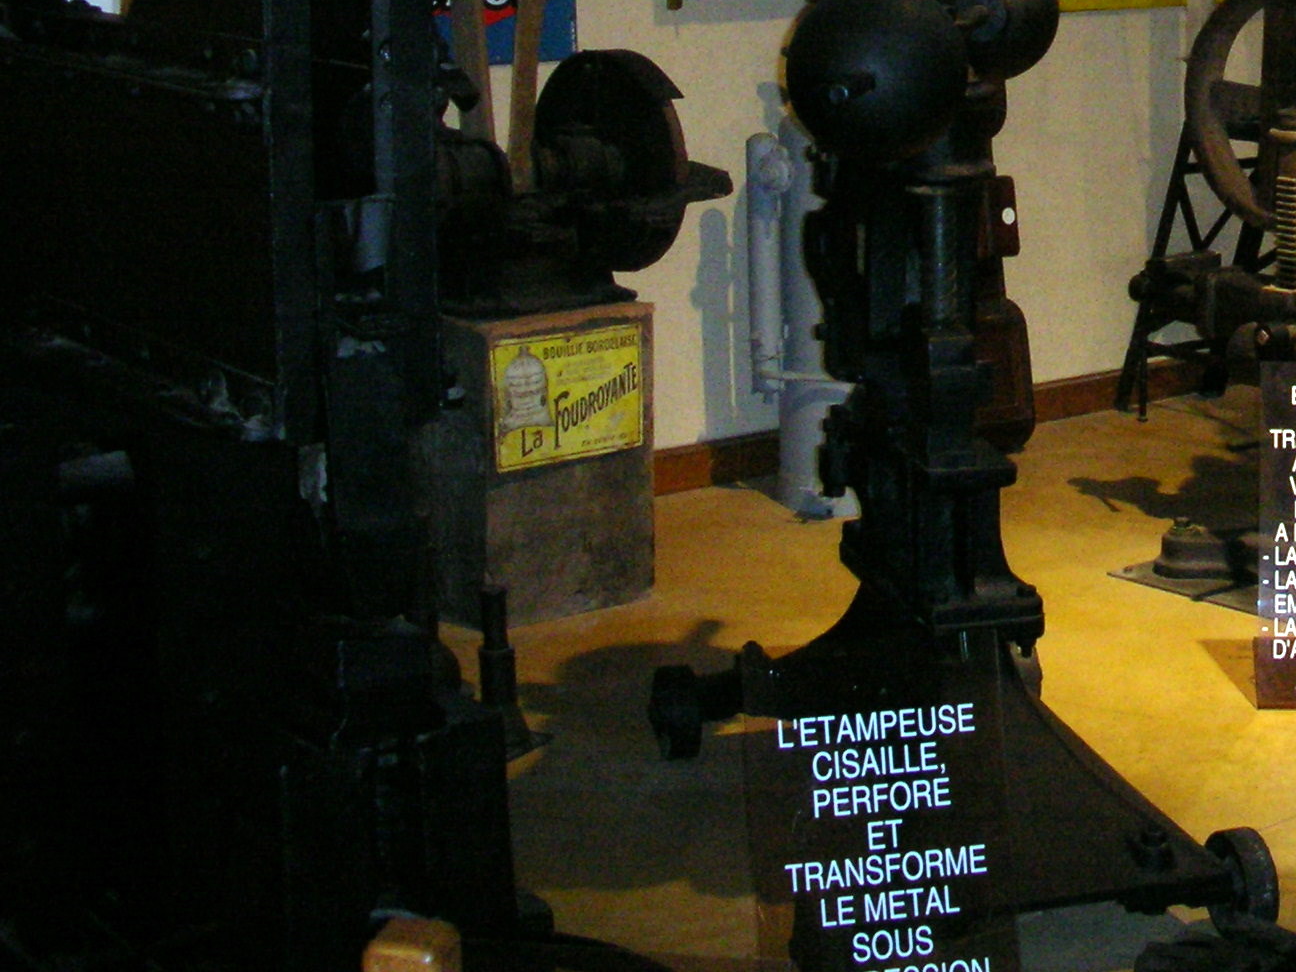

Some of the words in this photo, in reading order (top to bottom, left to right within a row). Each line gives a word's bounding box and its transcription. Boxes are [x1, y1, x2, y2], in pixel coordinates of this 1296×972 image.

[521, 428, 544, 457] La
[1274, 522, 1288, 542] A
[777, 703, 976, 749] L'ETAMPEUSE
[812, 741, 947, 782] CISAILLE,
[813, 777, 952, 819] PERFORE
[867, 819, 904, 851] ET
[784, 844, 988, 893] TRANSFORME
[820, 895, 856, 927] LE
[864, 885, 961, 922] METAL
[852, 925, 934, 963] SOUS
